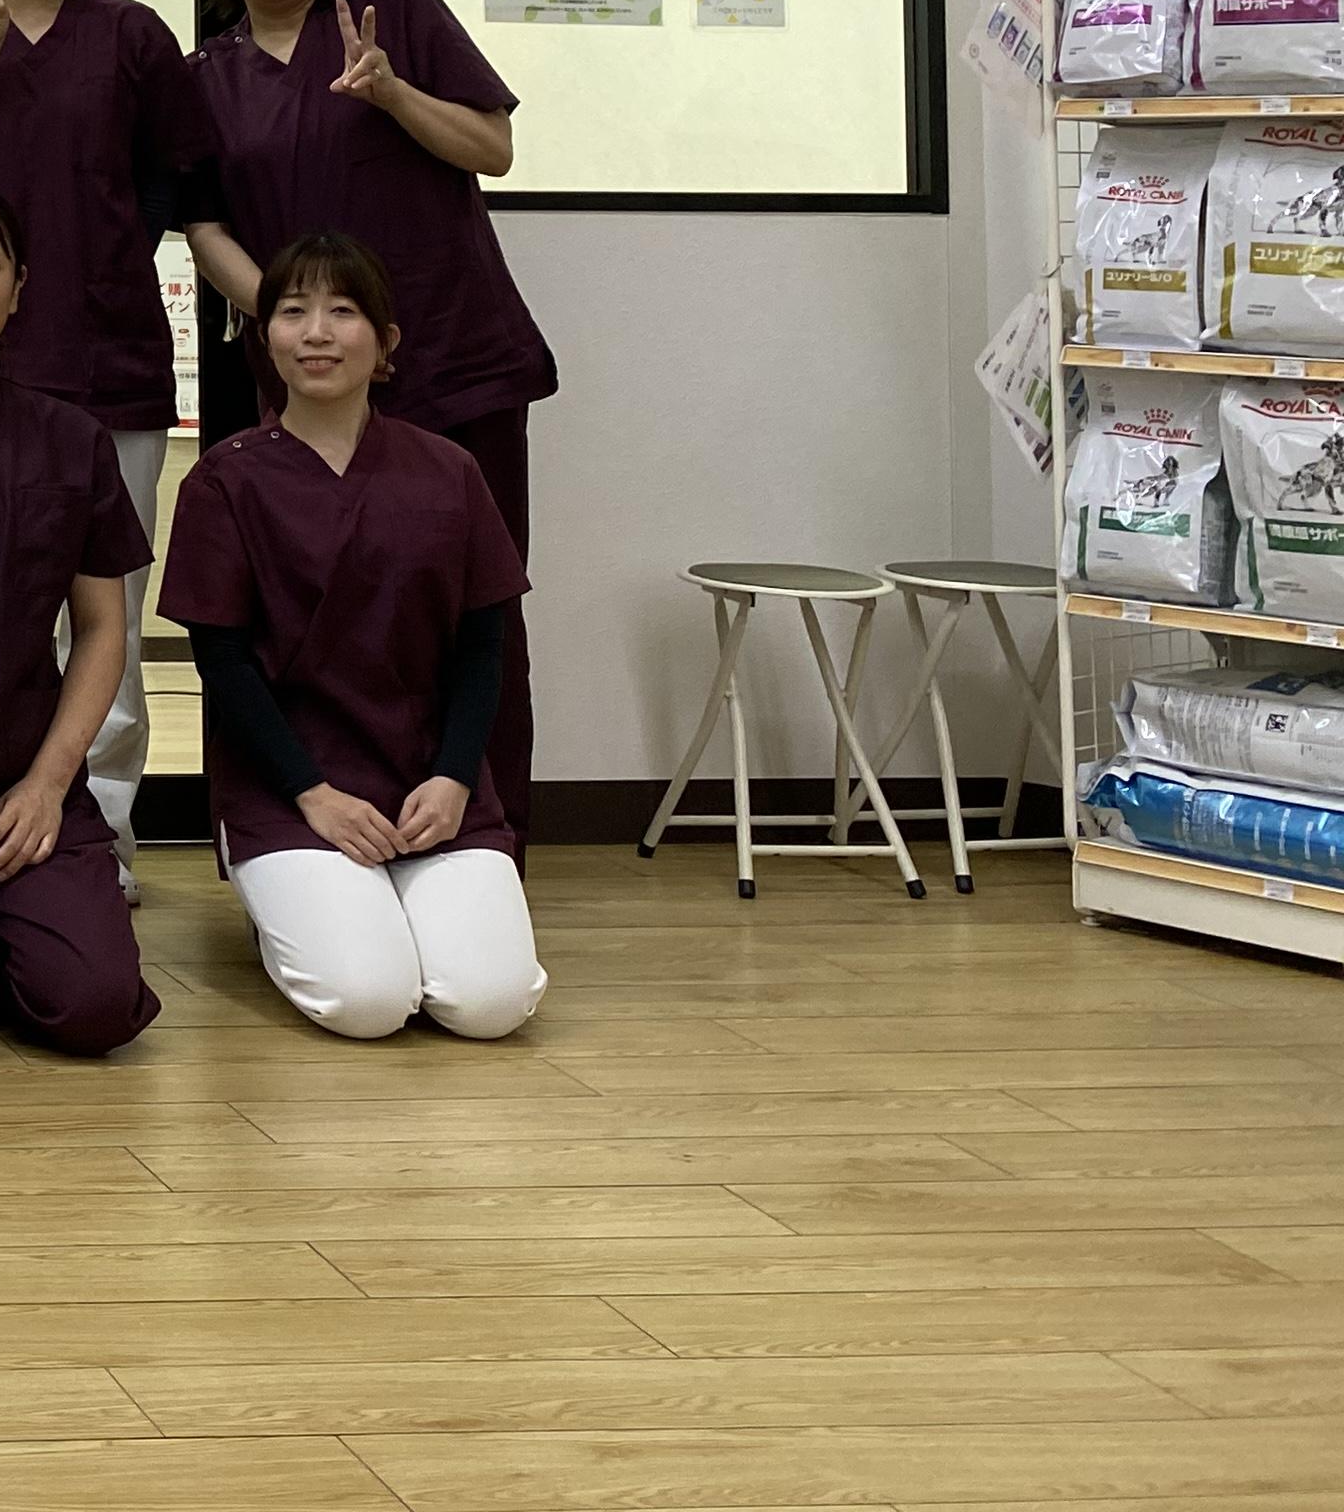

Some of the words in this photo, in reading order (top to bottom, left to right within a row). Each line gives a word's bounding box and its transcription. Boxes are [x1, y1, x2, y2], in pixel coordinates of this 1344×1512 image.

[1263, 126, 1318, 143] ROYAL
[1260, 397, 1313, 415] ROYAL
[1113, 422, 1155, 438] ROYAL
[1156, 427, 1193, 441] CANIN
